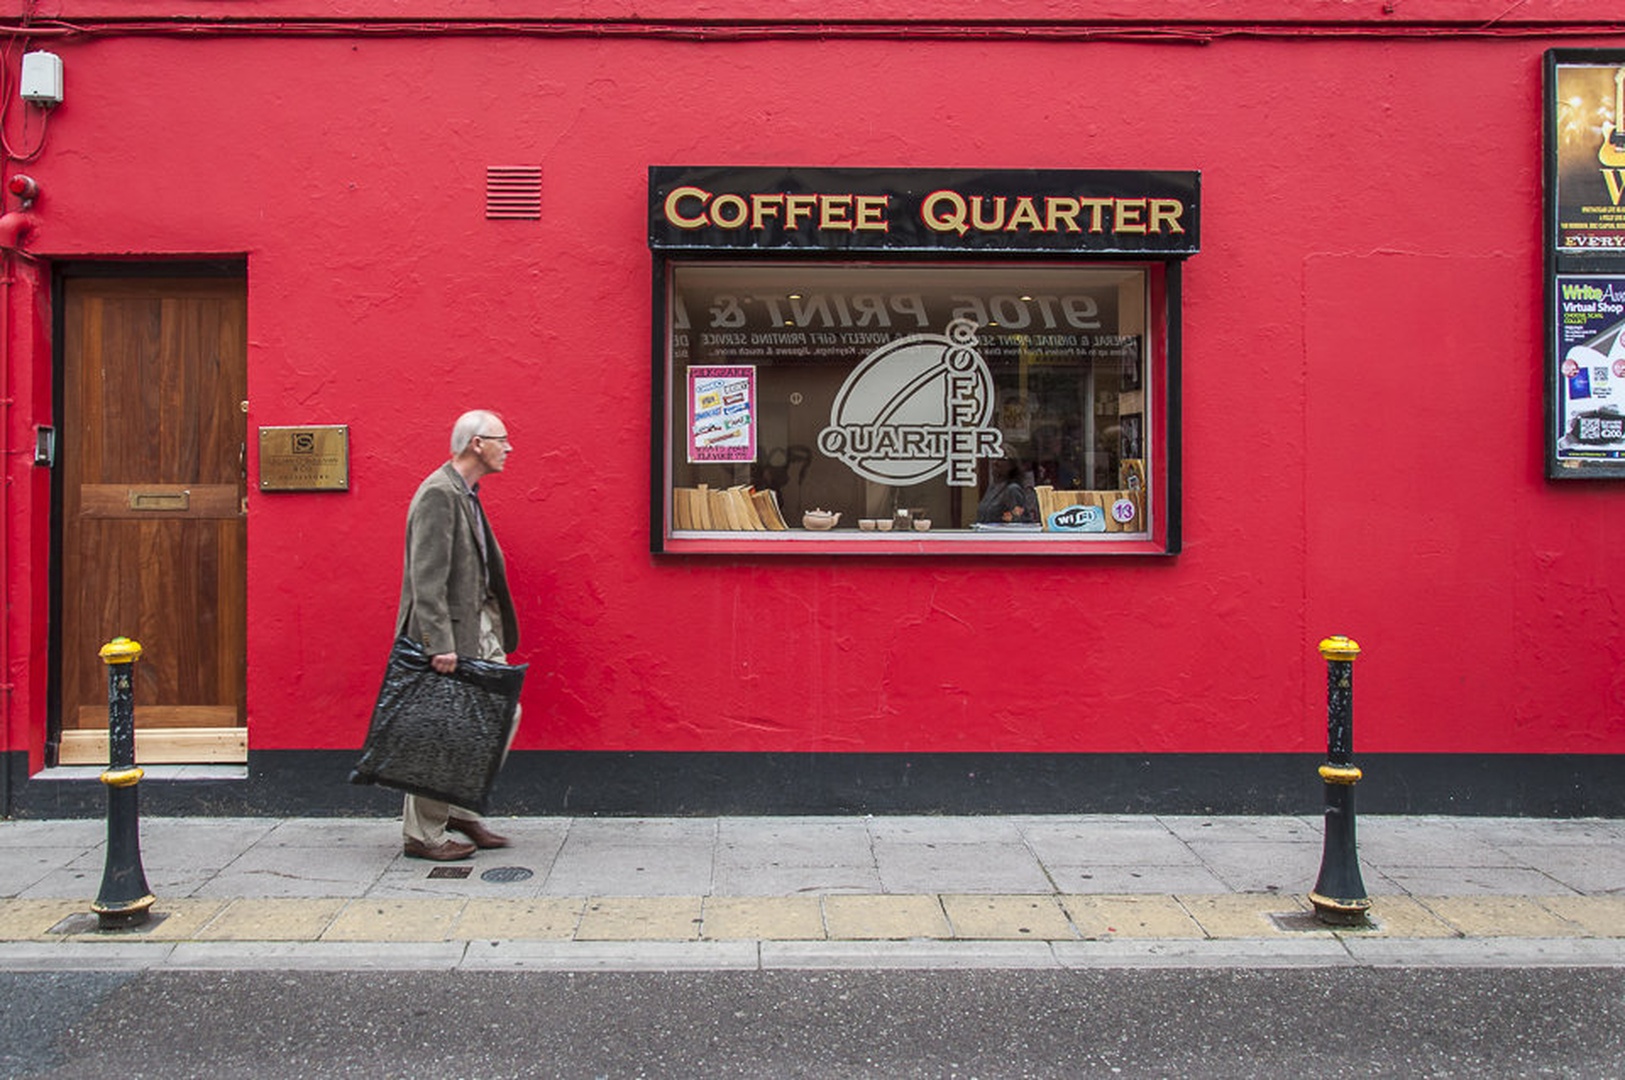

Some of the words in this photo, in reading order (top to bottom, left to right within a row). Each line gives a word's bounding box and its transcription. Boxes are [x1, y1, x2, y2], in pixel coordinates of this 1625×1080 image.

[664, 186, 889, 232] COFFEE
[920, 189, 1185, 237] QUARTER
[1563, 302, 1596, 312] Virtual
[1598, 302, 1624, 315] Shop
[820, 428, 1003, 459] QUARTER
[1115, 503, 1133, 519] 13
